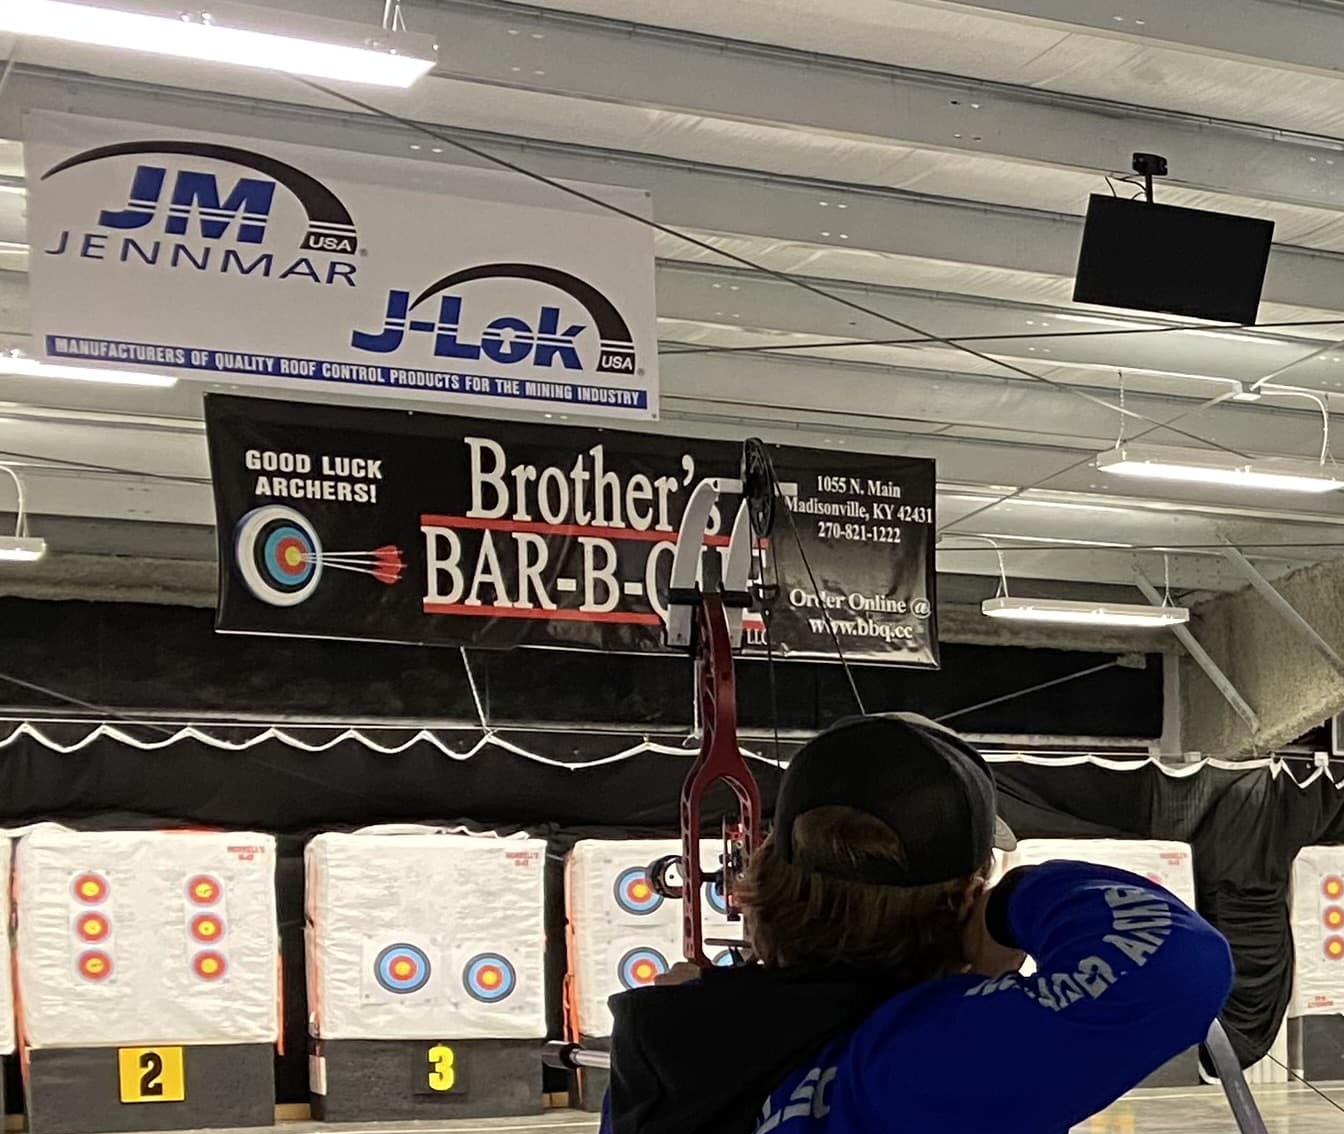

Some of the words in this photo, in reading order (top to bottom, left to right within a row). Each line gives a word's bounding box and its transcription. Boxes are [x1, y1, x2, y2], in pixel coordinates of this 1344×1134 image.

[99, 165, 277, 245] JM
[44, 230, 358, 288] JENNMAR
[308, 235, 352, 253] USA
[351, 288, 587, 371] J-Lok
[55, 337, 185, 364] MANUFACTURERS
[190, 351, 209, 367] OF
[214, 352, 275, 374] QUALITY
[280, 360, 317, 377] ROOF
[322, 361, 386, 384] CONTROL
[390, 369, 460, 391] PRODUCTS
[465, 375, 490, 392] FOR
[495, 379, 520, 396] THE
[525, 381, 573, 400] MINING
[577, 386, 640, 406] INDUSTRY
[601, 355, 634, 371] USA
[245, 448, 313, 475] GOOD
[320, 455, 382, 480] LUCK
[255, 476, 378, 504] ARCHERS!
[816, 475, 846, 492] 1055
[849, 479, 864, 496] N.
[867, 480, 901, 498] Main
[784, 495, 870, 521] Madisonville,
[872, 503, 894, 521] KY
[897, 505, 933, 524] 42431
[817, 521, 901, 544] 270-821-1222
[789, 588, 845, 611] Order
[848, 591, 906, 614] Online
[910, 597, 932, 620] @
[808, 617, 913, 643] www.bbq.cc
[139, 1050, 165, 1098] 2
[427, 1045, 456, 1092] 3
